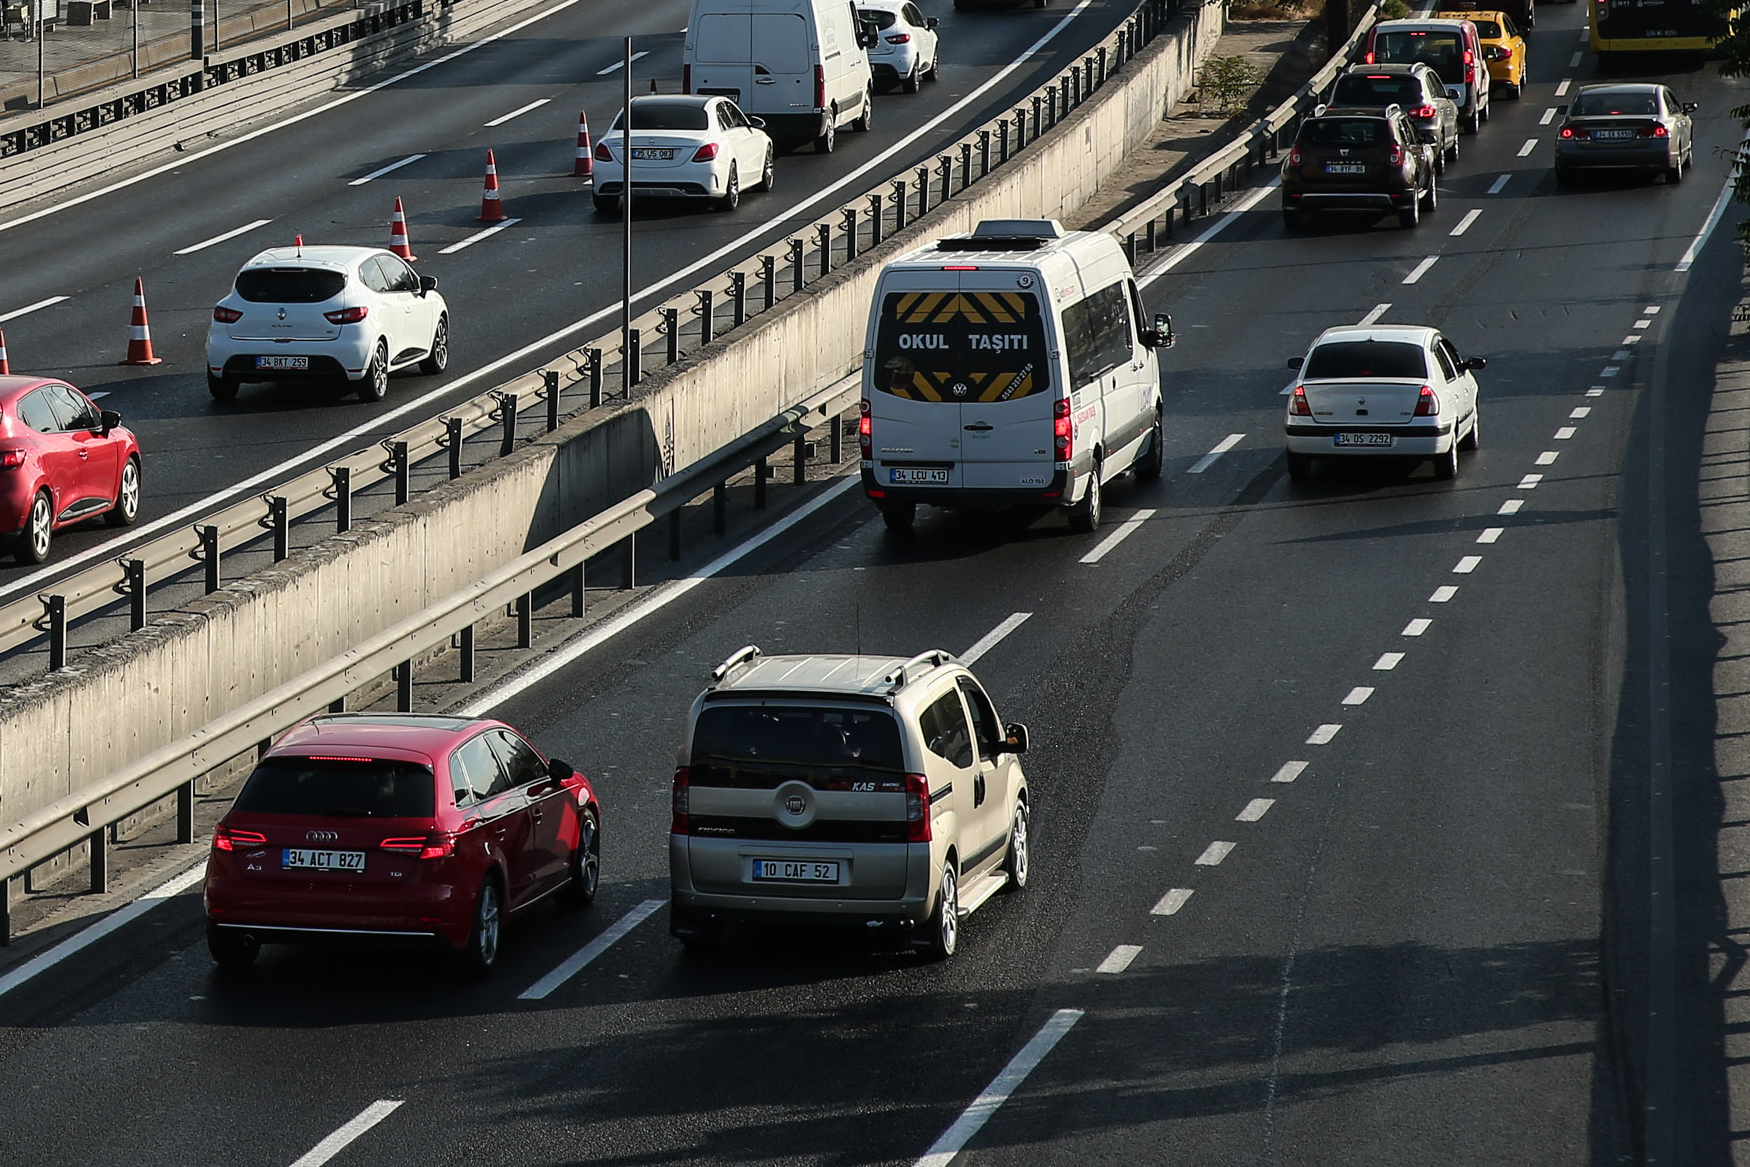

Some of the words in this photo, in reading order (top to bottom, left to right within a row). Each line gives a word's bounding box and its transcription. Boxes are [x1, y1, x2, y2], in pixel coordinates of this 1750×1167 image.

[898, 334, 949, 350] OKUL
[968, 334, 1028, 354] TAŞITI
[262, 357, 271, 366] 34
[274, 357, 288, 366] BKT
[292, 357, 307, 367] 259
[1340, 434, 1350, 443] 34
[1369, 434, 1389, 444] 2292
[895, 470, 906, 481] 34
[911, 470, 927, 481] LCU
[931, 471, 946, 482] 413
[290, 850, 304, 865] 34
[309, 852, 333, 867] ACT
[339, 853, 362, 867] 827
[764, 865, 776, 876] 10
[785, 866, 806, 877] CAF
[814, 866, 830, 878] 52
